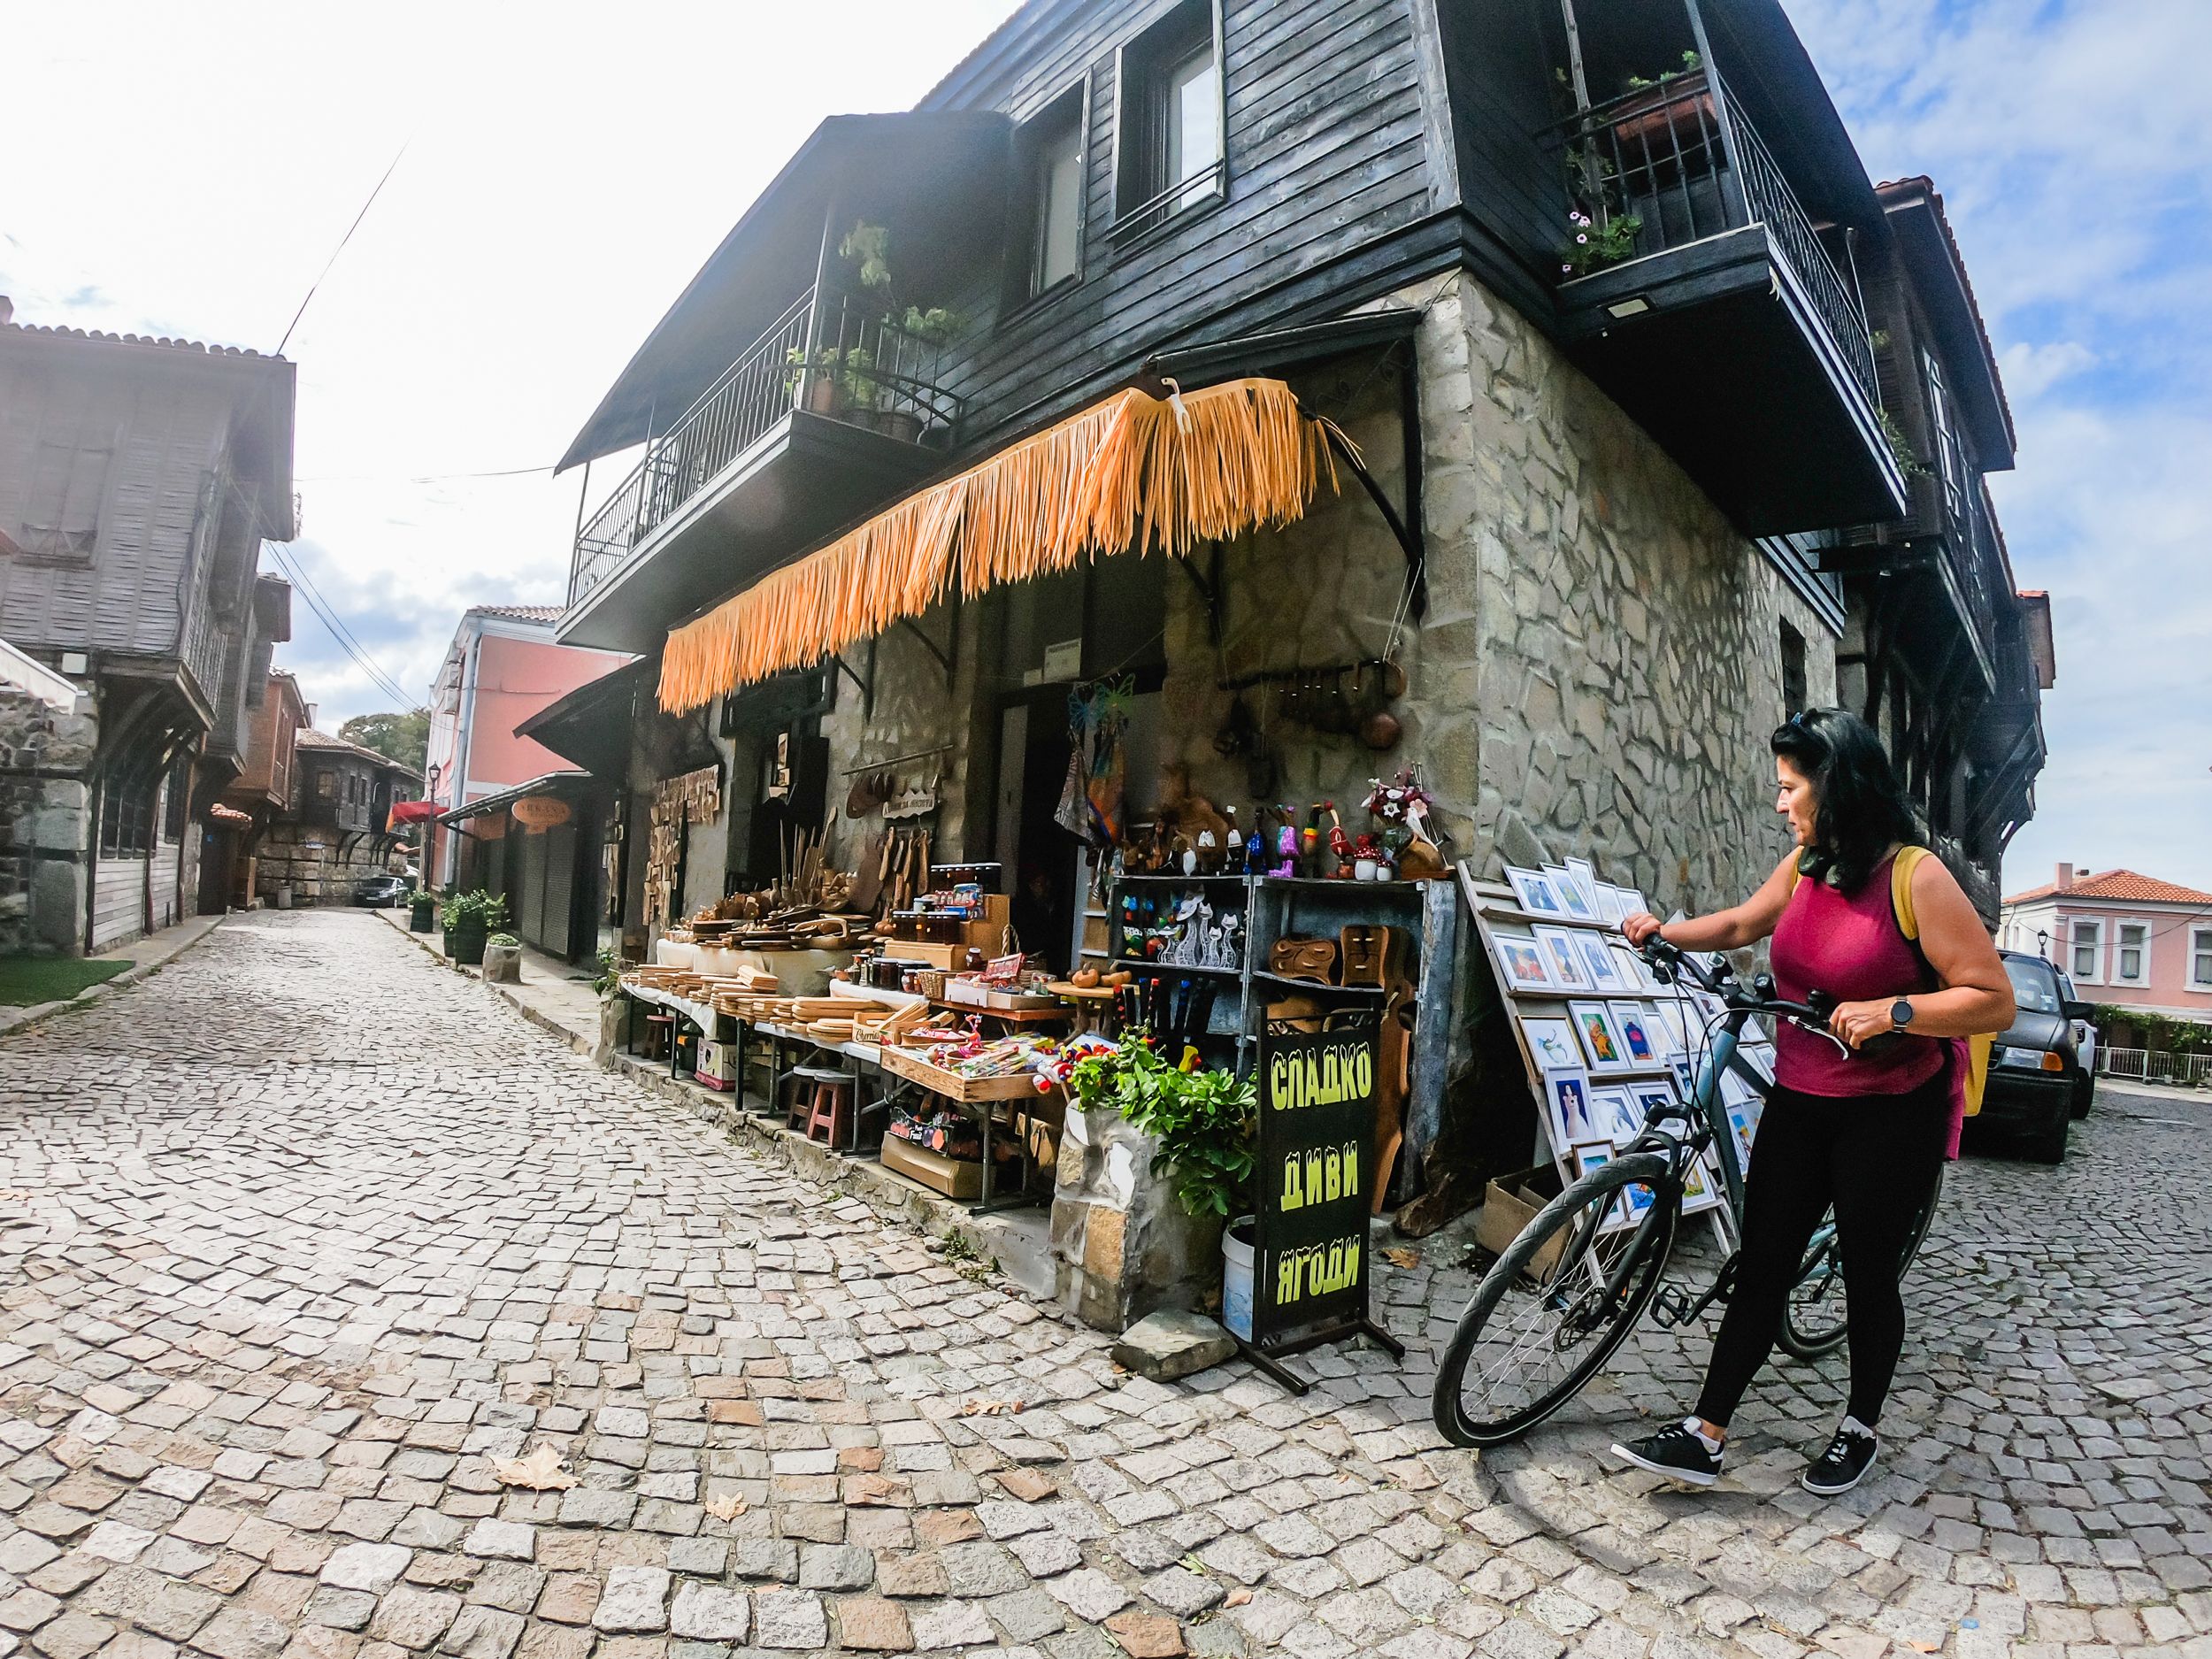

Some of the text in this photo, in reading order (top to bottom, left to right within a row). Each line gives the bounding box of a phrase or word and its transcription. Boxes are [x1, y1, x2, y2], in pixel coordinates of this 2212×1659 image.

[1271, 1041, 1371, 1110] СЛАДКО
[1280, 1140, 1358, 1213] ДИВИ
[1276, 1234, 1361, 1305] ЯГОДИ
